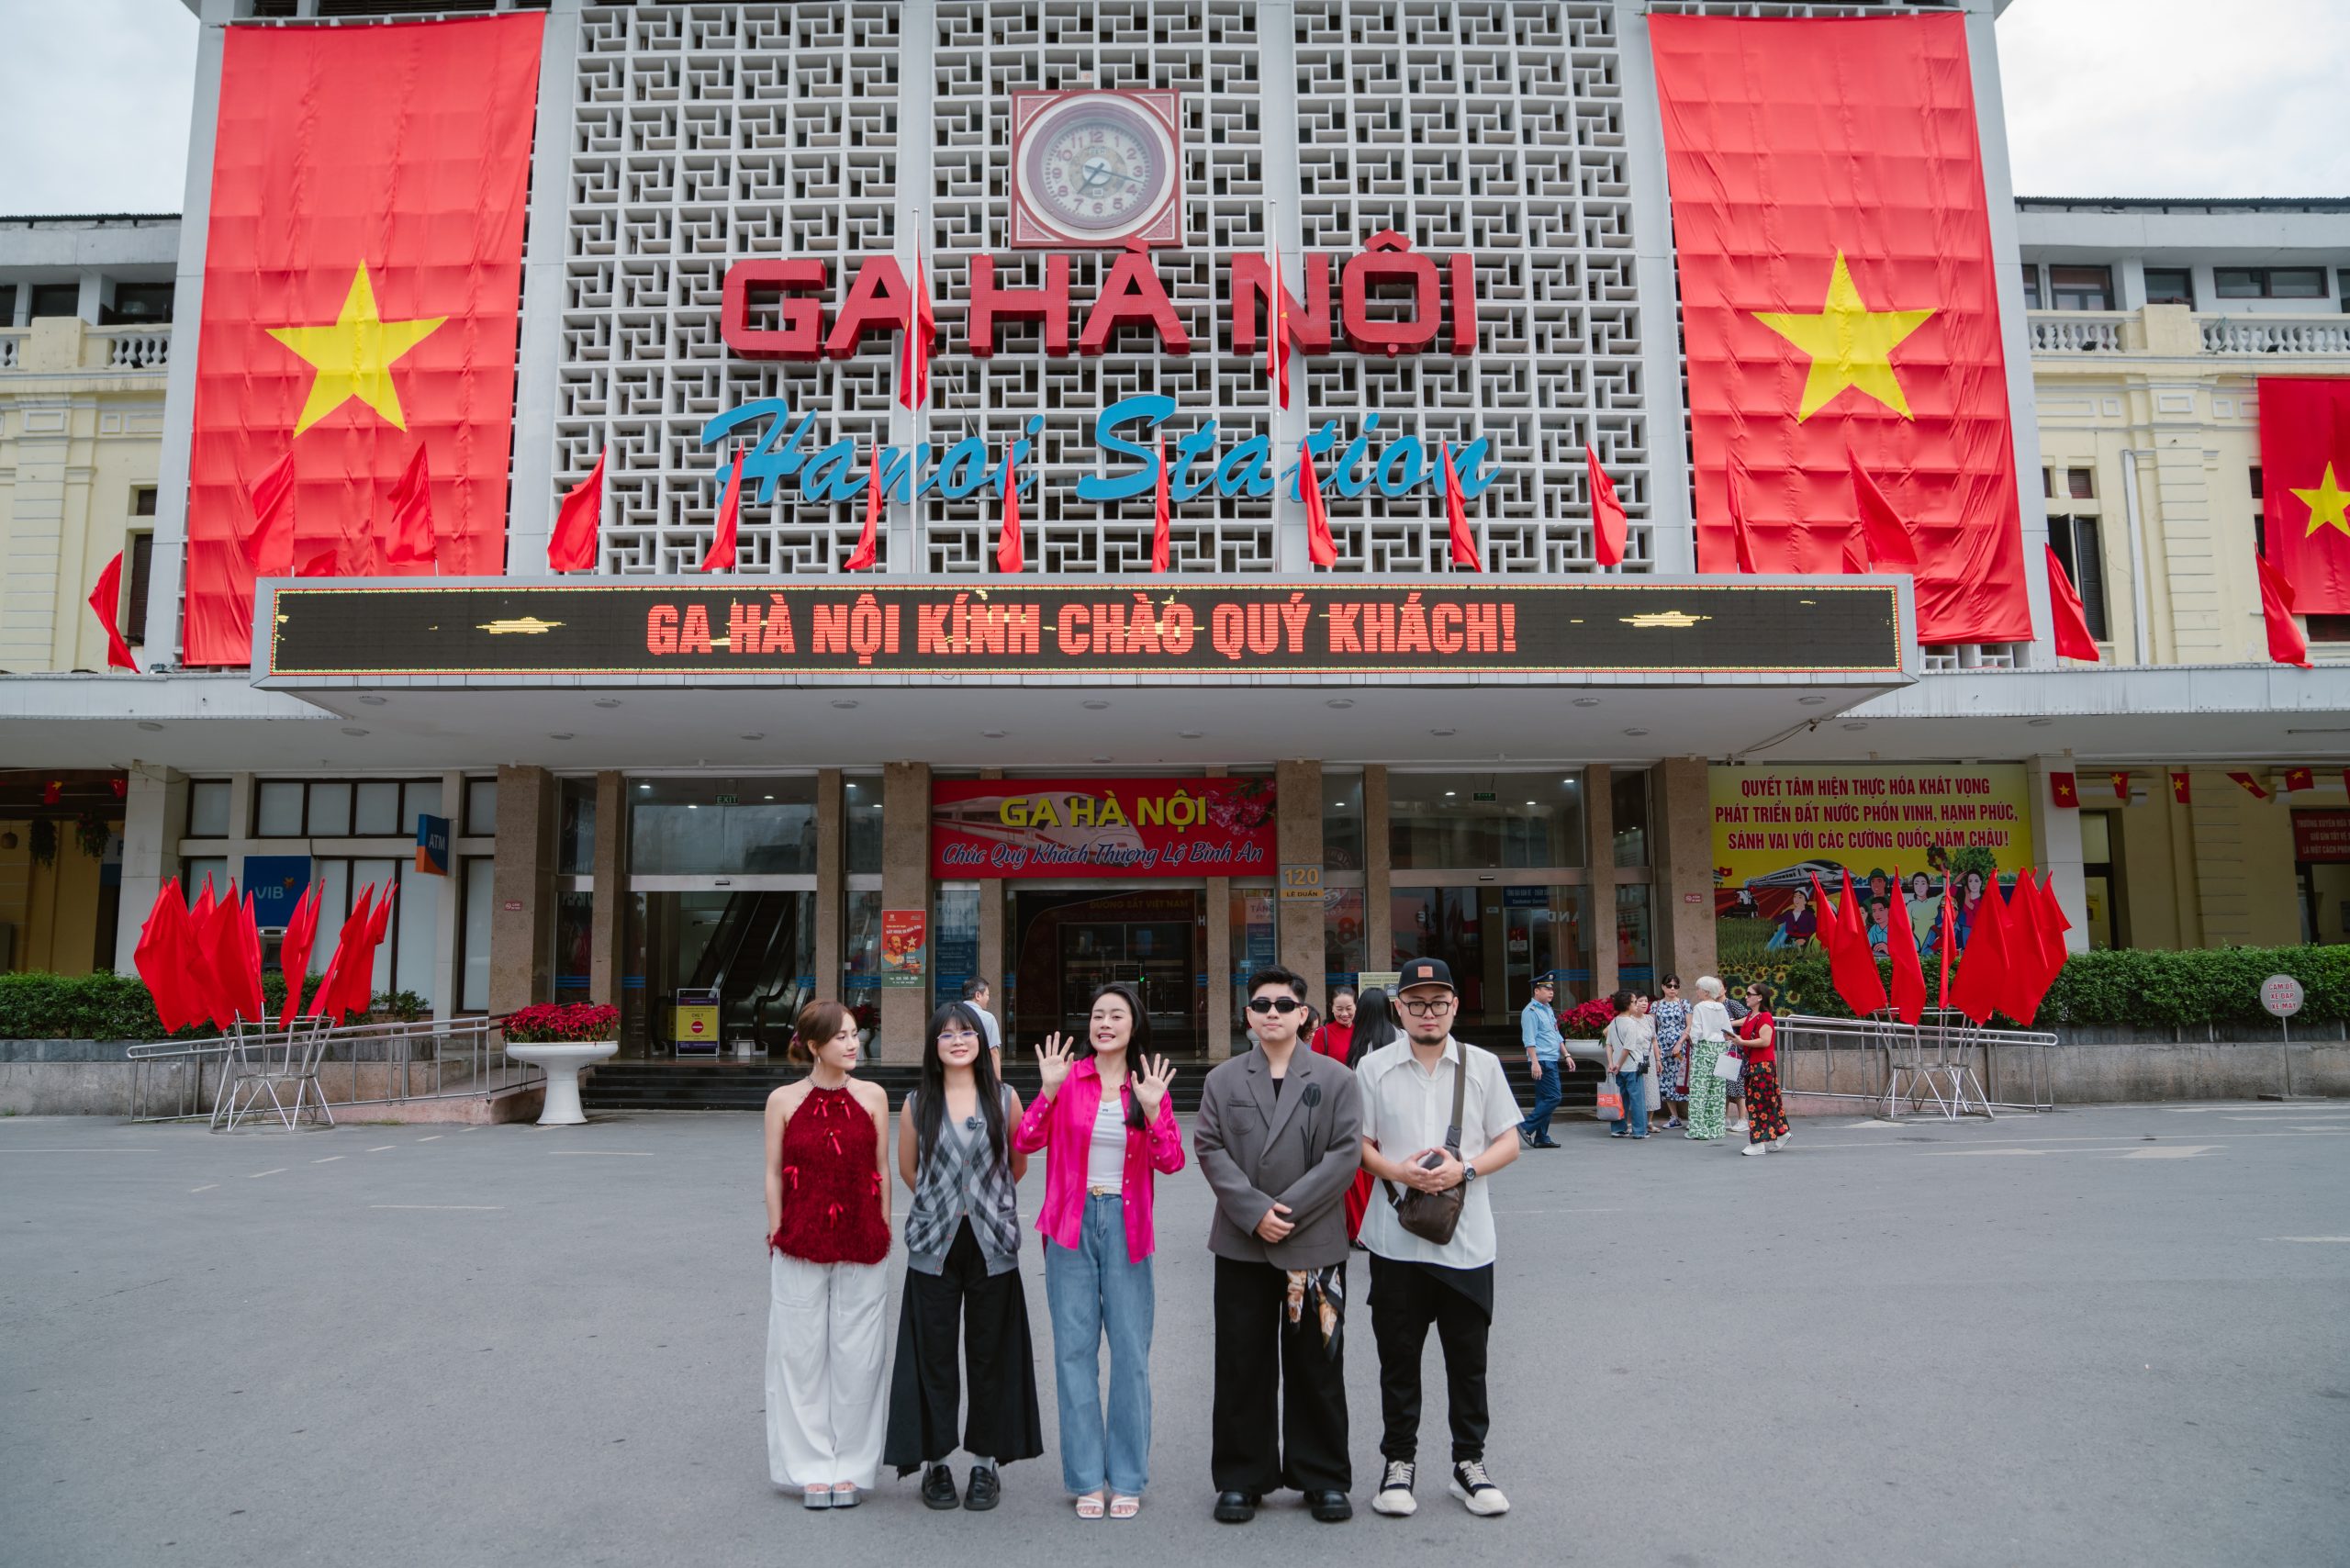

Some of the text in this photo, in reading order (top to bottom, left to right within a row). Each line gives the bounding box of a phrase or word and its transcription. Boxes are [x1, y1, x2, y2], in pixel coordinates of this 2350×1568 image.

[1071, 136, 1083, 149] 11
[1089, 131, 1103, 143] 12
[1114, 135, 1120, 148] 1
[1057, 150, 1073, 162] 10
[1126, 148, 1137, 161] 2
[1052, 167, 1062, 179] 9
[1133, 165, 1144, 178] 3
[1058, 185, 1069, 197] 8
[1125, 184, 1137, 196] 4
[1074, 198, 1084, 211] 7
[1092, 202, 1103, 214] 6
[1113, 198, 1123, 210] 5
[721, 229, 1477, 361] GA HÀ NỘI
[701, 394, 1503, 505] Hanoi Station
[646, 592, 1517, 665] GA HÀ NỘI KÍNH CHÀO QUÝ KHÁCH!
[1741, 775, 1990, 800] QUYẾT TÂM HIỆN THỰC HÓA KHÁT VỌNG
[717, 795, 738, 804] EXIT
[999, 789, 1208, 834] GA HÀ NỘI
[1715, 800, 2019, 824] PHÁT TRIỂN ĐẤT NƯỚC PHỒN VINH, HẠNH PHÚC,
[429, 833, 446, 851] ATM
[1728, 825, 2009, 850] SÁNH VAI VỚI CÁC CƯỜNG QUỐC NĂM CHÂU!
[942, 840, 1264, 870] Chúc Quý Khách Thượng Lộ Bình An
[1285, 868, 1319, 886] 120
[254, 886, 285, 900] VIB
